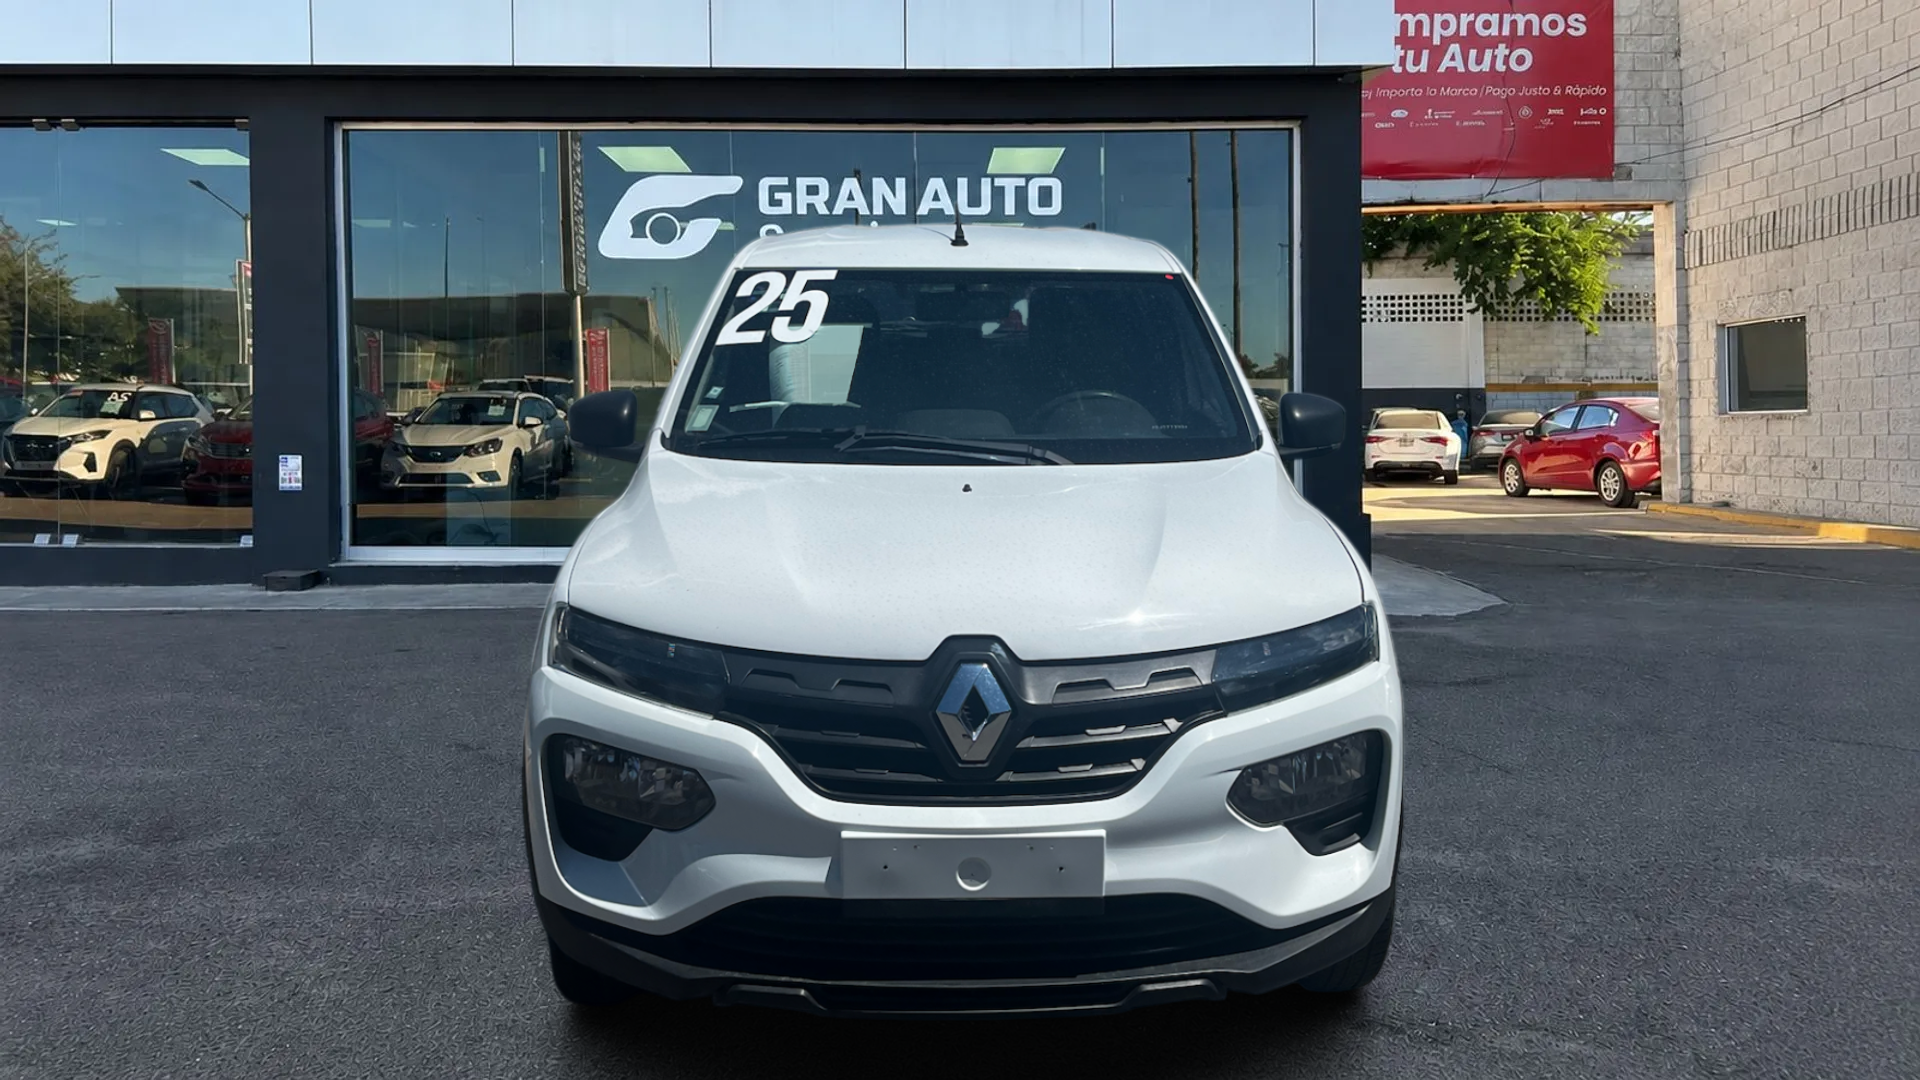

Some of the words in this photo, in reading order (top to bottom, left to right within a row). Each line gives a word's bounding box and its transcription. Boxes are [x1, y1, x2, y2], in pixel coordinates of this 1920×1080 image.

[1392, 44, 1428, 73] tu
[1437, 43, 1533, 73] Auto
[1375, 87, 1423, 99] Importa
[1426, 86, 1437, 96] la
[1440, 86, 1478, 96] Marca
[1485, 86, 1516, 99] Pago
[1518, 86, 1550, 96] Justo
[1553, 86, 1562, 96] &
[1565, 84, 1607, 99] Rápido
[758, 176, 907, 216] GRAN
[916, 176, 1063, 216] AUTO
[716, 269, 839, 346] 25
